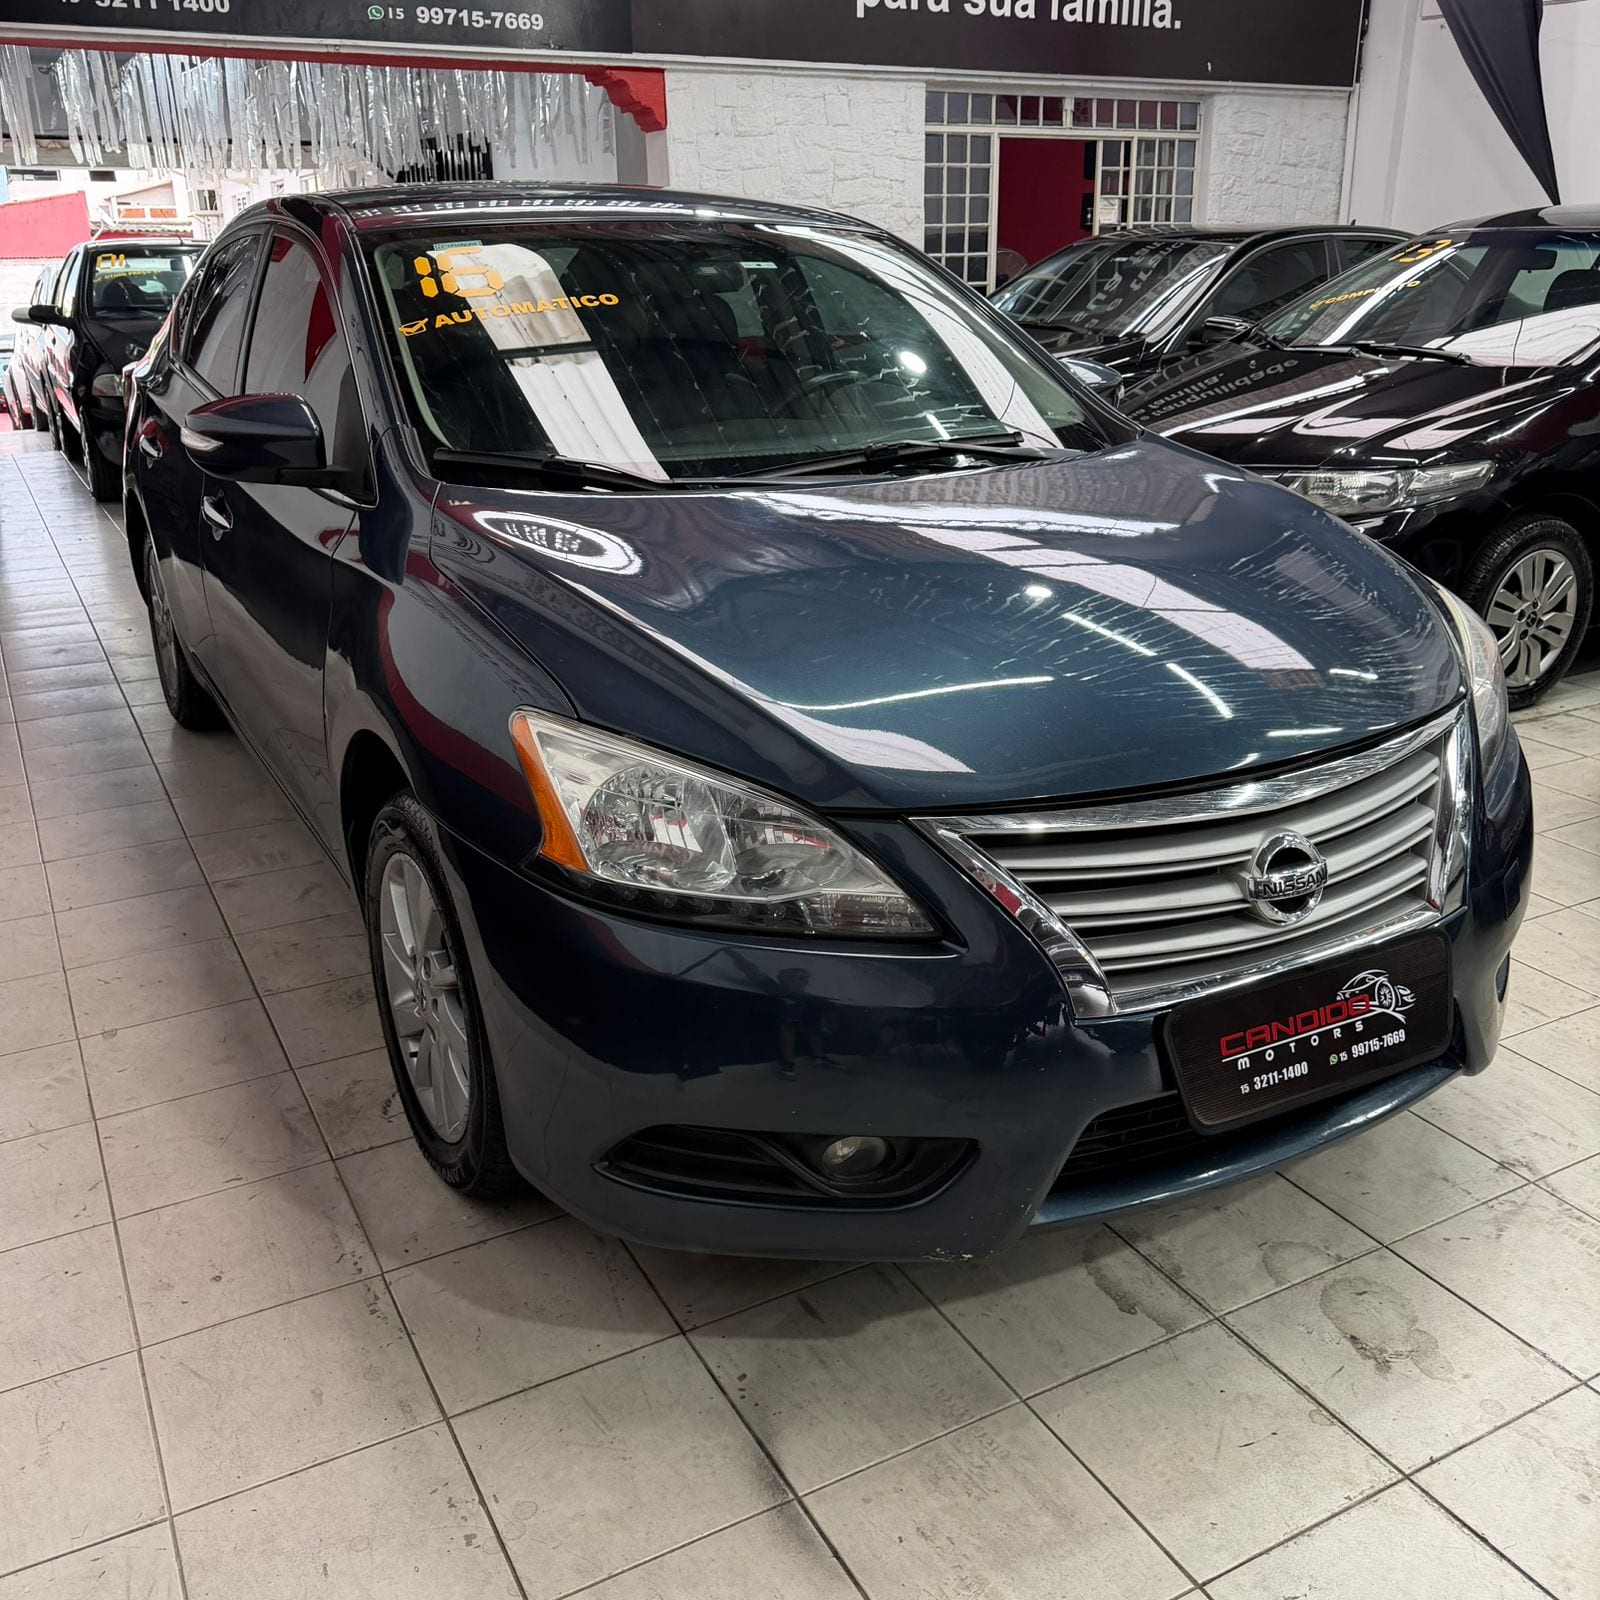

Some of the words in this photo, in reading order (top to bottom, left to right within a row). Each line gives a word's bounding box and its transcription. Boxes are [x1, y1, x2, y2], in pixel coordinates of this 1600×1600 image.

[388, 7, 404, 19] 15
[416, 6, 544, 30] 99715-7669
[413, 247, 504, 298] 16
[1325, 280, 1421, 304] COMPLTO
[435, 293, 619, 328] AUTOMATICO
[1262, 863, 1327, 897] NISSAN
[1220, 994, 1370, 1056] CANDIDO
[1237, 1021, 1364, 1070] MOTORS
[1339, 1052, 1348, 1062] 15
[1352, 1029, 1406, 1058] 99715-7669
[1240, 1084, 1250, 1094] 15
[1253, 1061, 1309, 1091] 3211-1400
